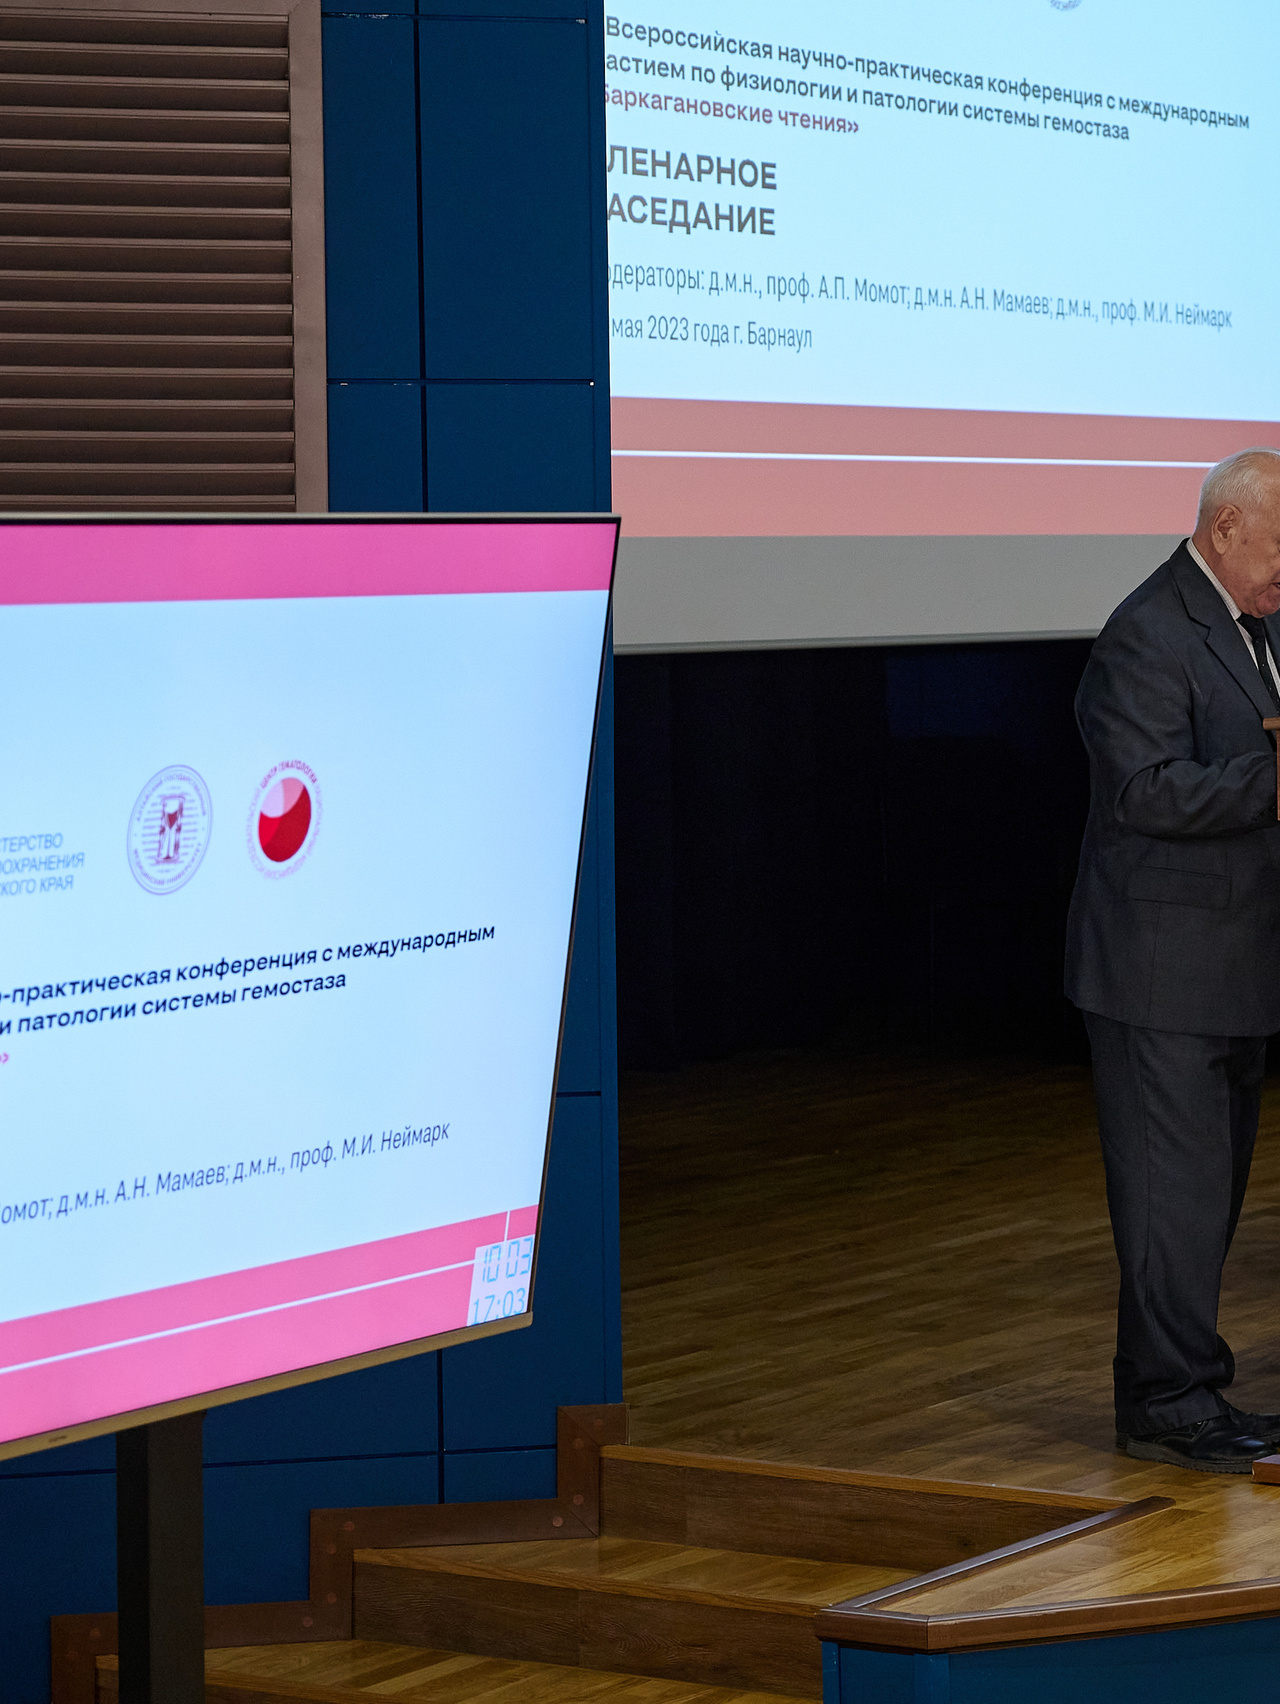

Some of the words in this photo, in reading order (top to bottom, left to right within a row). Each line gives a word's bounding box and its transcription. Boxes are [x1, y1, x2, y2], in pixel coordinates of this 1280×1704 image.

[606, 15, 773, 60] Всероссийская
[777, 45, 983, 90] научно-практическая
[988, 77, 1103, 108] конференция
[1106, 95, 1116, 110] с
[1119, 96, 1250, 129] международным
[606, 54, 686, 80] астием
[691, 65, 716, 84] по
[720, 65, 842, 101] физиологии
[846, 87, 858, 103] и
[862, 89, 959, 117] патологии
[963, 104, 1040, 128] системы
[1043, 114, 1130, 141] гемостаза
[778, 109, 859, 133] чтения»
[608, 144, 777, 190] ЛЕНАРНОЕ
[608, 193, 775, 236] АСЕДАНИЕ
[708, 270, 762, 299] д.м.н.,
[766, 272, 814, 304] проф.
[818, 275, 850, 301] А.П.
[855, 278, 911, 310] Момот;
[914, 287, 957, 311] д.м.н.
[960, 286, 989, 311] А.Н.
[993, 289, 1053, 320] Мамаев;
[1056, 297, 1099, 323] д.м.н.,
[1102, 298, 1140, 327] проф.
[1143, 300, 1172, 324] М.И.
[1175, 303, 1233, 333] Неймарк
[611, 317, 643, 339] мая
[648, 315, 689, 341] 2023
[693, 322, 729, 347] года
[734, 325, 743, 344] г.
[747, 321, 813, 353] Барнаул
[40, 874, 74, 892] КРАЯ
[0, 968, 171, 1007] -практическая
[176, 949, 317, 982] конференция
[322, 948, 333, 962] с
[337, 926, 495, 960] международным
[18, 1003, 136, 1033] патологии
[142, 989, 237, 1015] системы
[241, 973, 346, 1001] гемостаза
[56, 1188, 110, 1218] д.м.н.
[114, 1176, 150, 1203] А.Н.
[155, 1165, 231, 1195] Мамаев;
[233, 1155, 285, 1184] д.м.н.,
[290, 1140, 337, 1172] проф.
[342, 1134, 376, 1159] М.И.
[380, 1122, 451, 1151] Неймарк
[472, 1288, 526, 1325] 17:03
